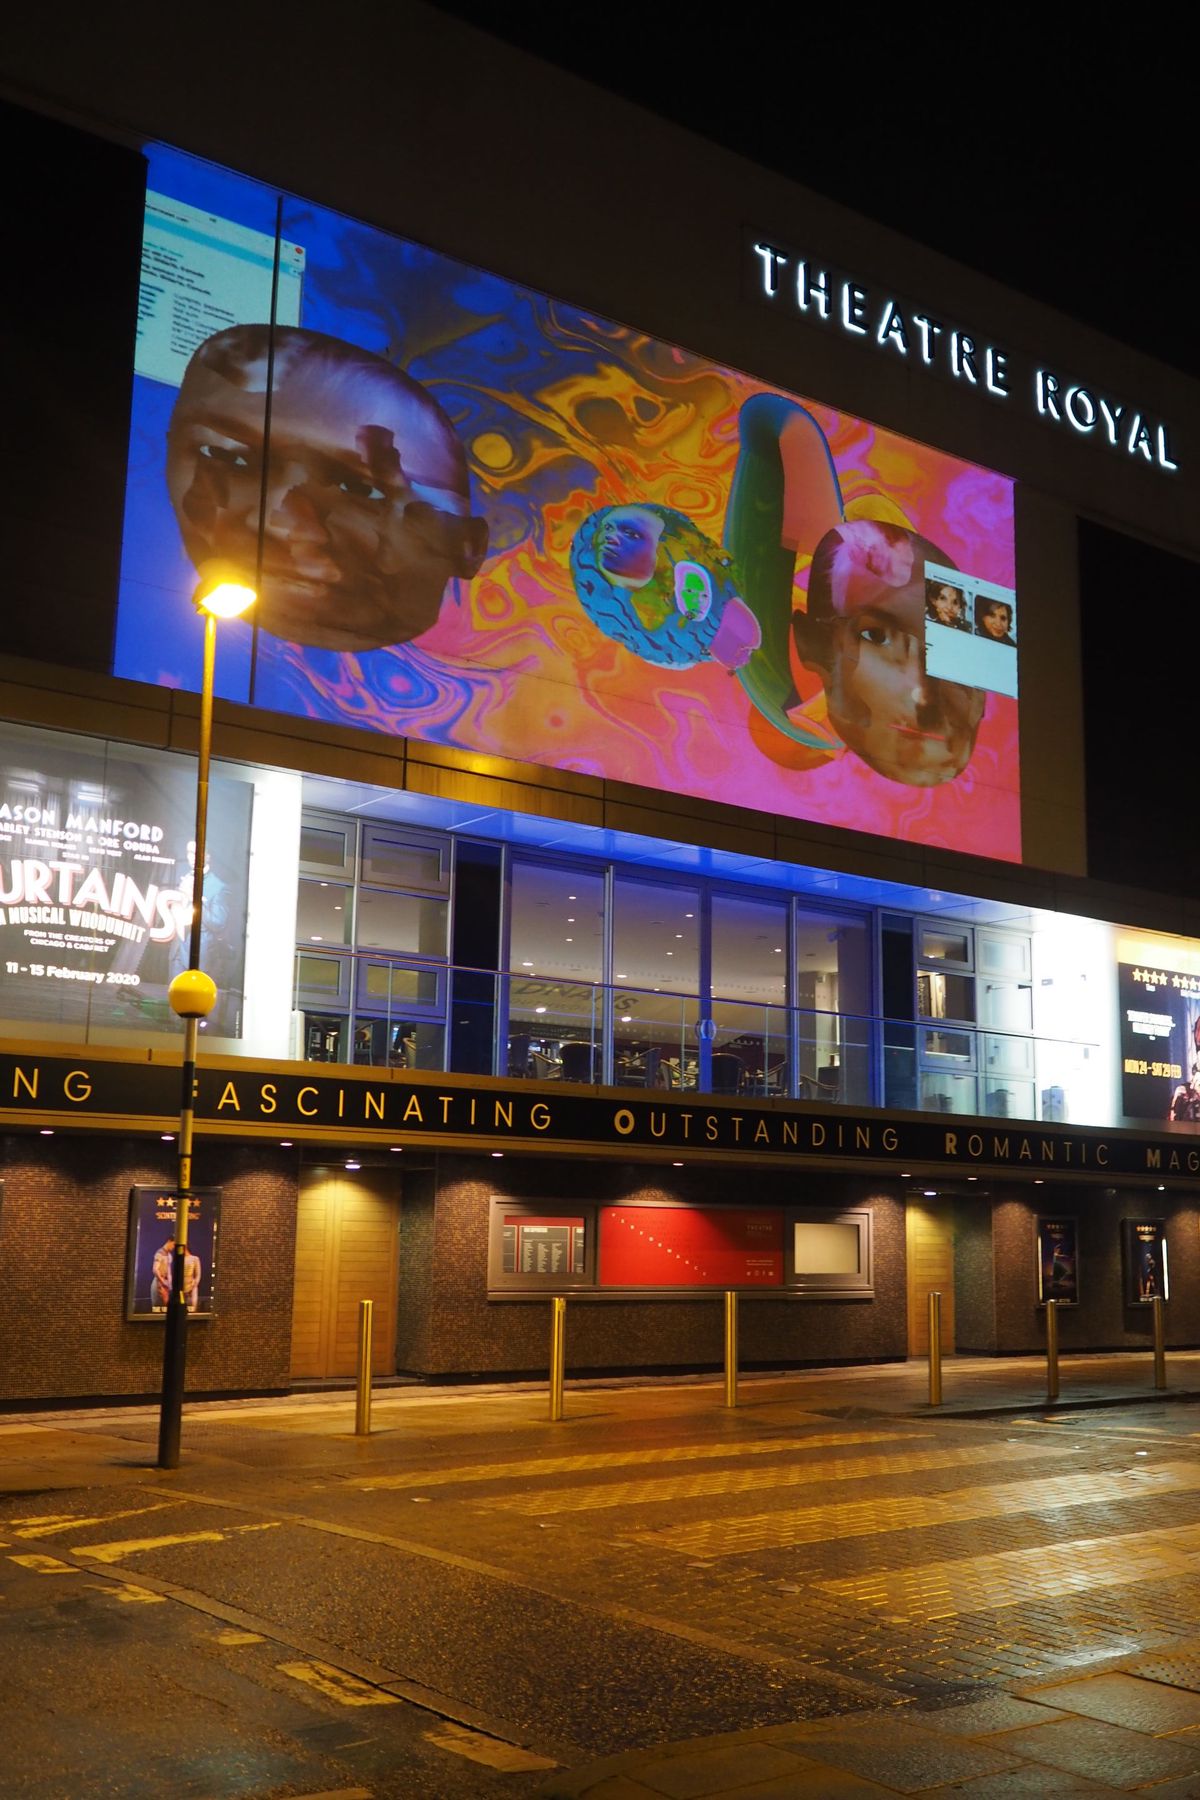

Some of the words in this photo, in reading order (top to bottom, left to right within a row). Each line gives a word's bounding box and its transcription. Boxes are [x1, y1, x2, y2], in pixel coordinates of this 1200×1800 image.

[753, 241, 1011, 397] THEATRE
[1036, 368, 1179, 471] ROYAL
[34, 827, 82, 842] STENSON
[98, 837, 120, 849] ORE
[65, 813, 164, 842] MANFORD
[0, 859, 188, 943] URTAINS
[9, 906, 66, 925] MUSICAL
[69, 909, 146, 943] WHODUNNIT
[23, 929, 47, 938] FROM
[48, 932, 63, 940] THE
[64, 934, 103, 945] CREATORS
[104, 938, 116, 946] OF
[30, 938, 65, 948] CHICAGO
[74, 943, 109, 952] CABARET
[6, 961, 19, 973] 11
[30, 964, 44, 976] 15
[47, 965, 105, 984] February
[106, 972, 140, 986] 2020
[13, 1066, 92, 1102] NG
[192, 1079, 551, 1130] ASCINATING
[613, 1109, 899, 1151] OUTSTANDING
[944, 1132, 1109, 1166] ROMANTIC
[1146, 1148, 1200, 1172] MAG
